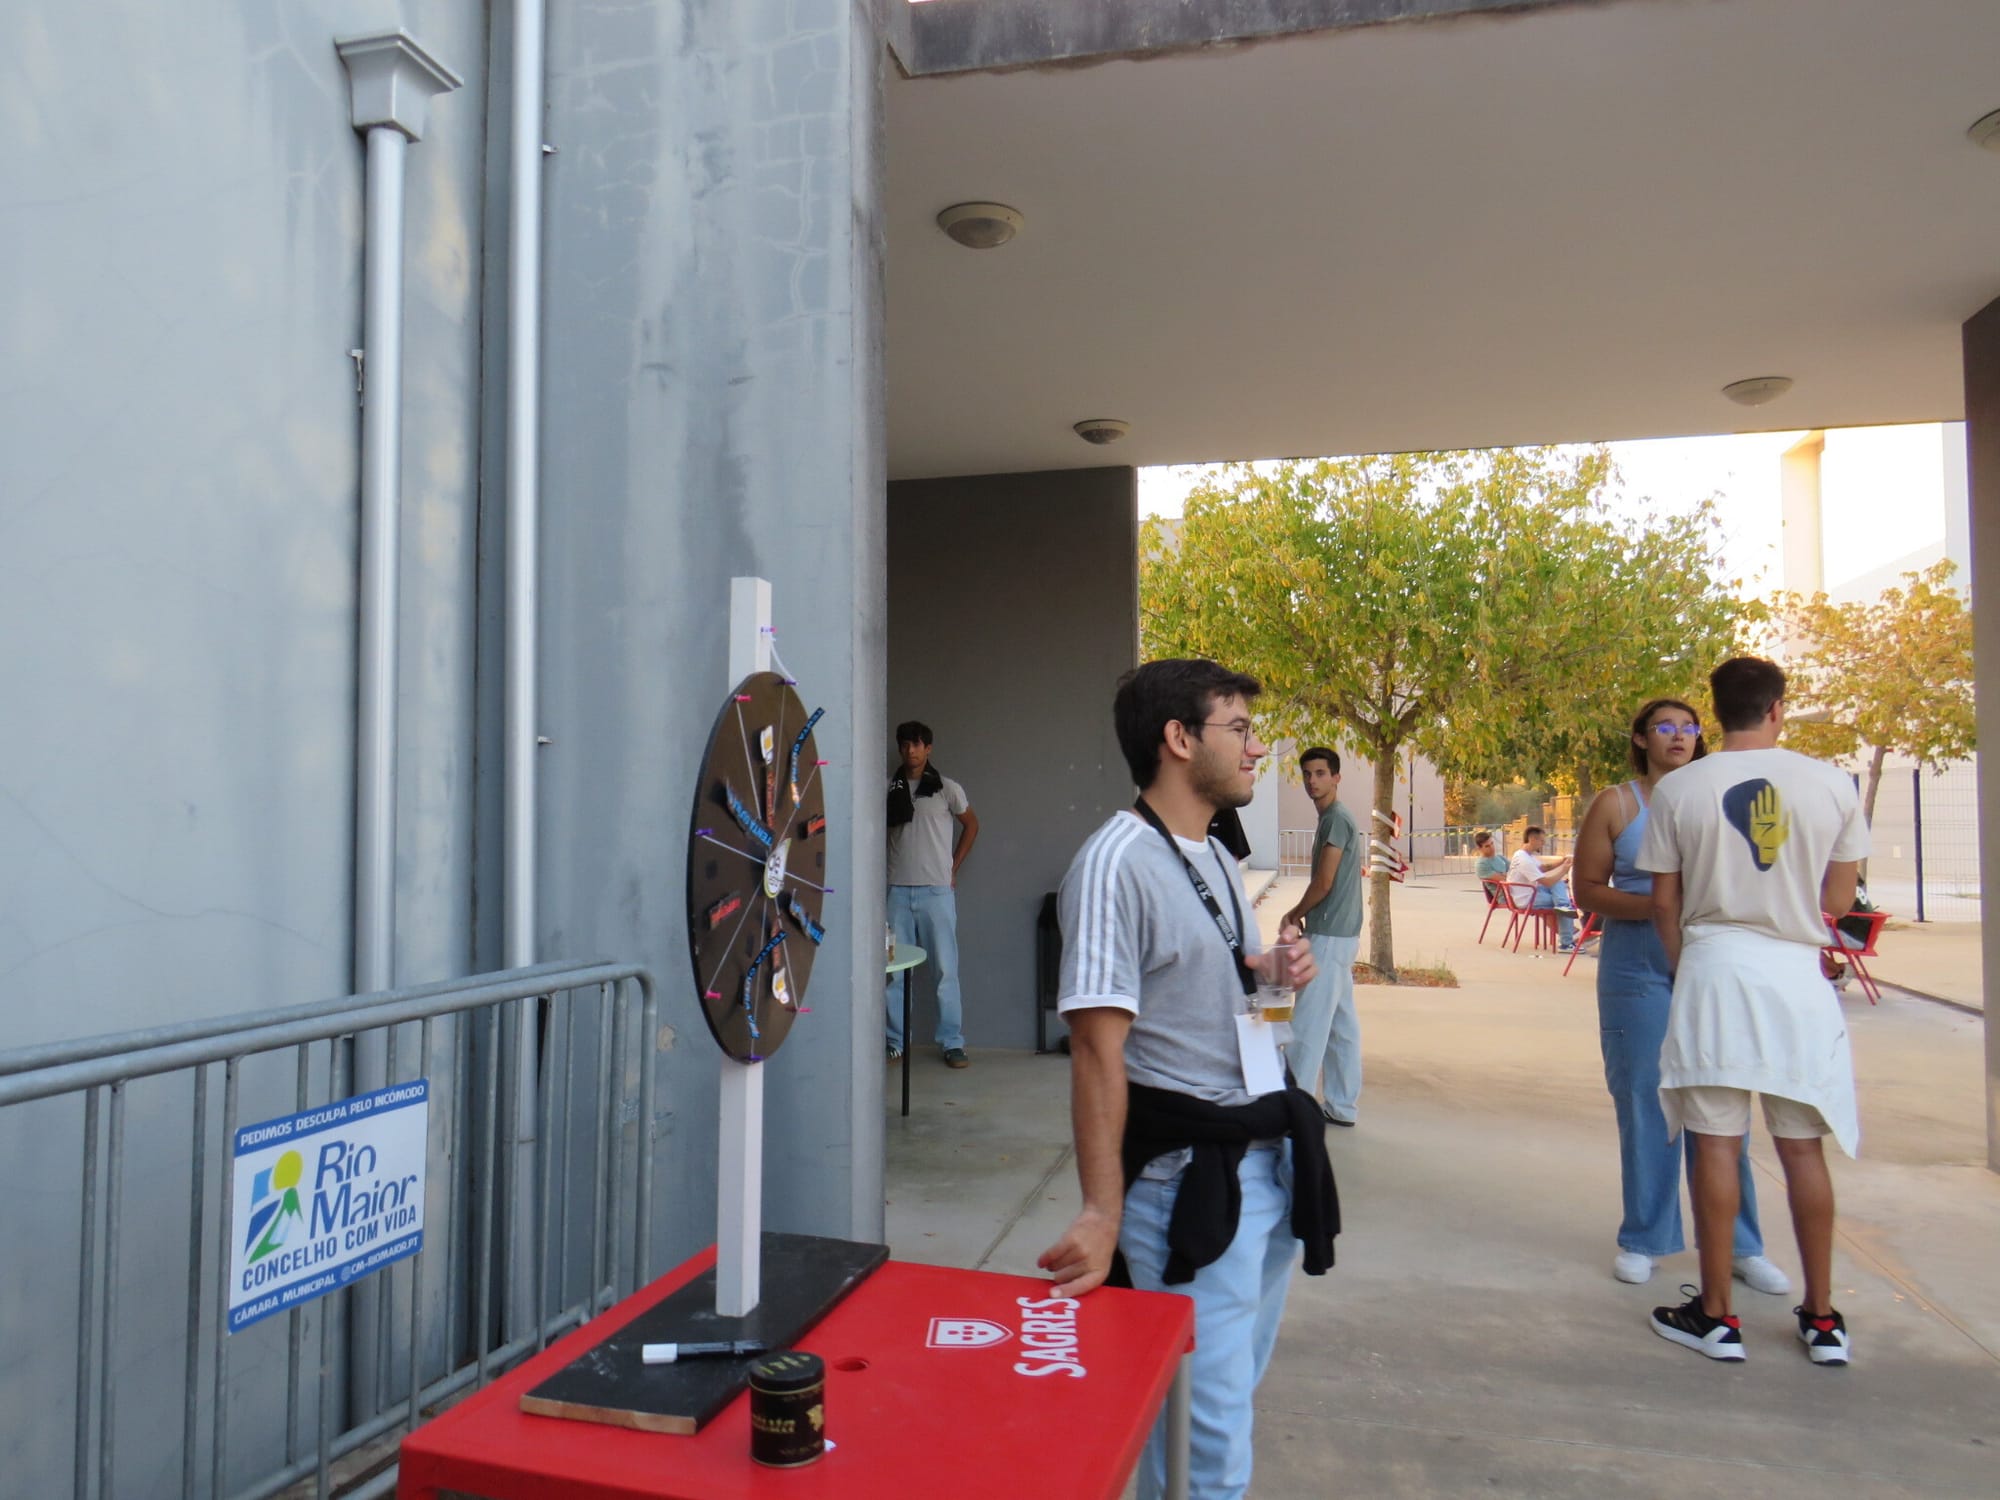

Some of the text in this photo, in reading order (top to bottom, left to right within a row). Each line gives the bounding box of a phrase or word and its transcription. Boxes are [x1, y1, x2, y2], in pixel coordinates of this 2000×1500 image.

[240, 1121, 292, 1147] PEDIMOS
[295, 1105, 347, 1131] DESCULPA
[350, 1097, 372, 1115] PELO
[315, 1139, 377, 1190] Rio
[309, 1174, 417, 1240] Maior
[242, 1205, 417, 1292] CONCELHO COM VIDA
[282, 1273, 337, 1302] MUNICIPAL
[1013, 1295, 1087, 1378] SAGRES
